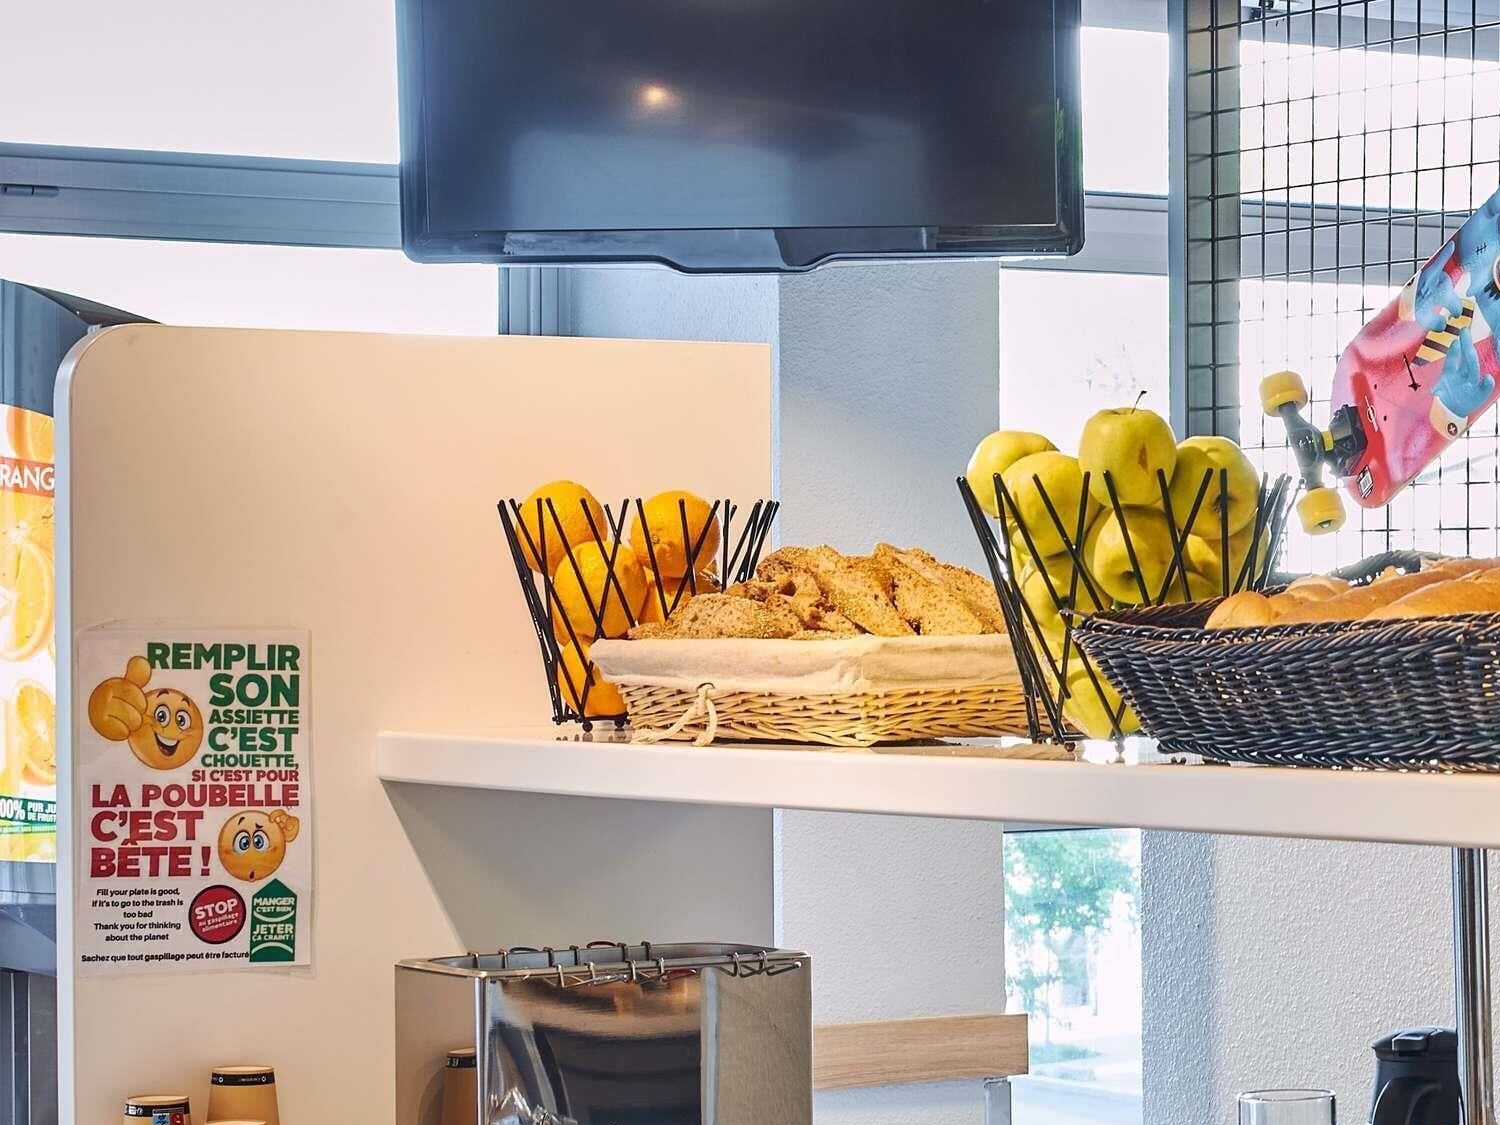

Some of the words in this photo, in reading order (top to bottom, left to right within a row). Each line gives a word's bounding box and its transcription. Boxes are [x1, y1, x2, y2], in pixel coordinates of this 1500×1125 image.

[0, 463, 55, 491] RANG
[147, 642, 300, 671] REMPLIR
[208, 673, 300, 708] SON
[208, 710, 300, 725] ASSIETTE
[207, 726, 299, 753] C'EST
[200, 754, 300, 770] CHOUETTE,
[191, 770, 206, 783] SI
[209, 769, 252, 783] C'EST
[256, 770, 299, 782] POUR
[91, 784, 132, 808] LA
[141, 783, 300, 808] POUBELLE
[0, 799, 26, 820] 00%
[45, 803, 56, 814] JU
[90, 810, 205, 843] C'EST
[90, 837, 193, 878] BÊTE
[200, 846, 211, 877] !
[129, 889, 149, 897] plate
[253, 897, 295, 906] MANGER
[195, 898, 238, 920] STOP
[148, 922, 181, 930] thinking
[253, 924, 294, 934] JETER
[105, 934, 129, 942] about
[144, 934, 169, 942] planet
[81, 954, 110, 962] Sachez
[111, 955, 126, 963] que
[144, 953, 185, 962] gaspillage
[186, 953, 204, 961] peut
